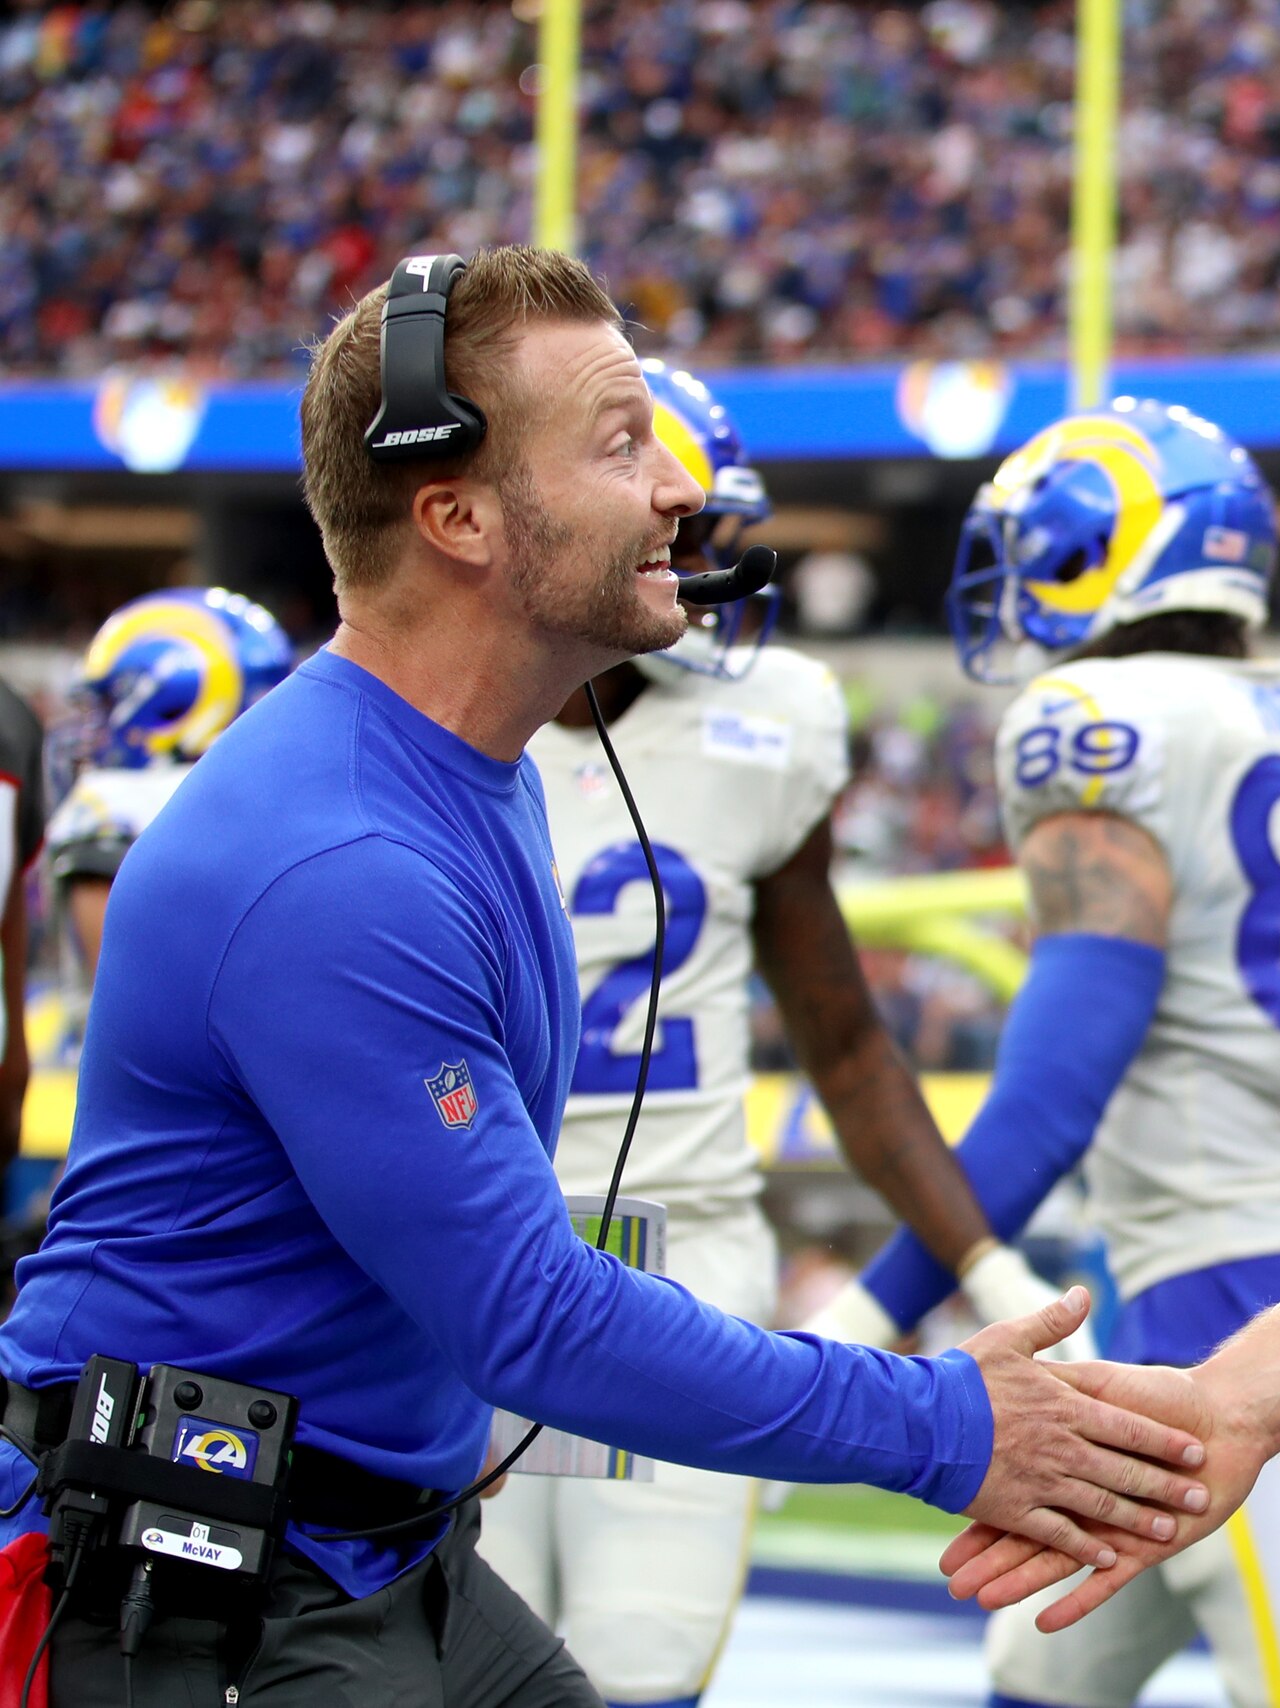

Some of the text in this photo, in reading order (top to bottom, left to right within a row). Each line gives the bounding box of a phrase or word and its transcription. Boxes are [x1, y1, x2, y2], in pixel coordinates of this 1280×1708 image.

[372, 423, 462, 448] BOSE
[1014, 721, 1141, 788] 89
[571, 840, 709, 1094] 2
[440, 1087, 477, 1123] NFL
[193, 1527, 206, 1540] 01
[182, 1542, 222, 1561] McVAY
